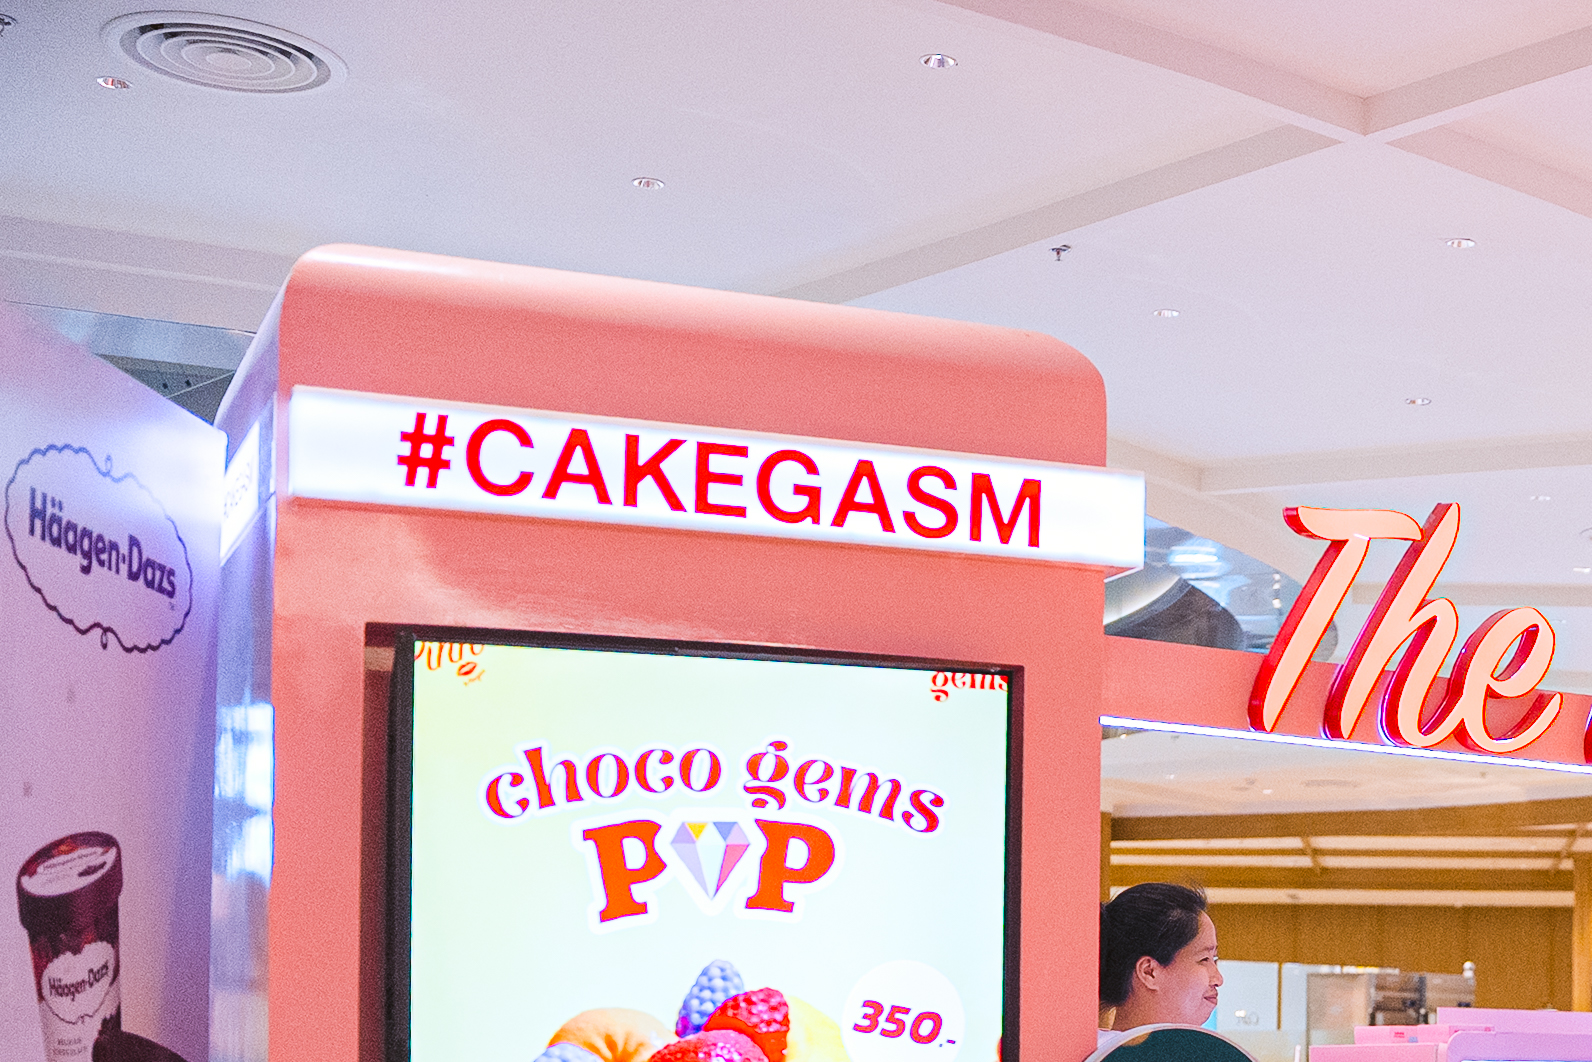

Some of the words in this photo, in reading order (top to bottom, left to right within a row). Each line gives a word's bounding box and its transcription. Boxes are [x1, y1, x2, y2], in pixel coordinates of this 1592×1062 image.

[28, 486, 176, 599] Häagen-Dazs
[397, 411, 1042, 549] #CAKEGASM
[1248, 502, 1563, 753] The
[486, 746, 722, 819] choco
[743, 740, 946, 834] gems
